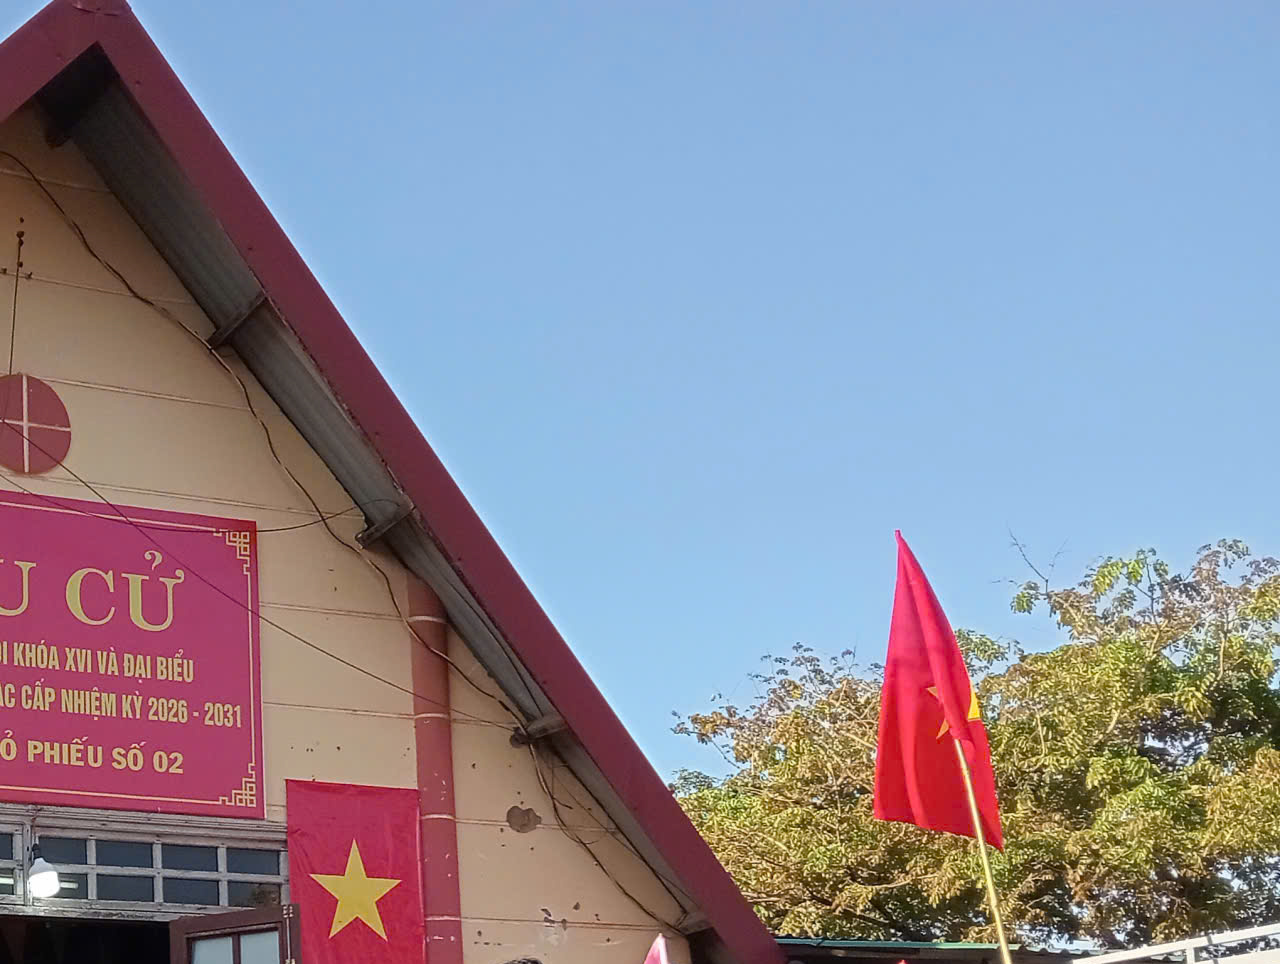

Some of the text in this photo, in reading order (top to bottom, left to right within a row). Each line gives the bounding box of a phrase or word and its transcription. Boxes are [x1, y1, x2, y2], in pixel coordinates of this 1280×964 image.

[65, 550, 185, 632] CỬ
[13, 639, 60, 670] KHÓA
[64, 647, 92, 673] XVI
[96, 646, 119, 676] VÀ
[123, 653, 152, 684] ĐẠI
[156, 648, 194, 683] BIỂU
[21, 680, 56, 711] CẤP
[60, 686, 117, 721] NHIỆM
[121, 690, 143, 719] KỲ
[148, 696, 188, 724] 2026
[204, 702, 242, 728] 2031
[27, 736, 103, 768] PHIẾU
[111, 741, 147, 771] SỐ
[152, 750, 184, 774] 02
